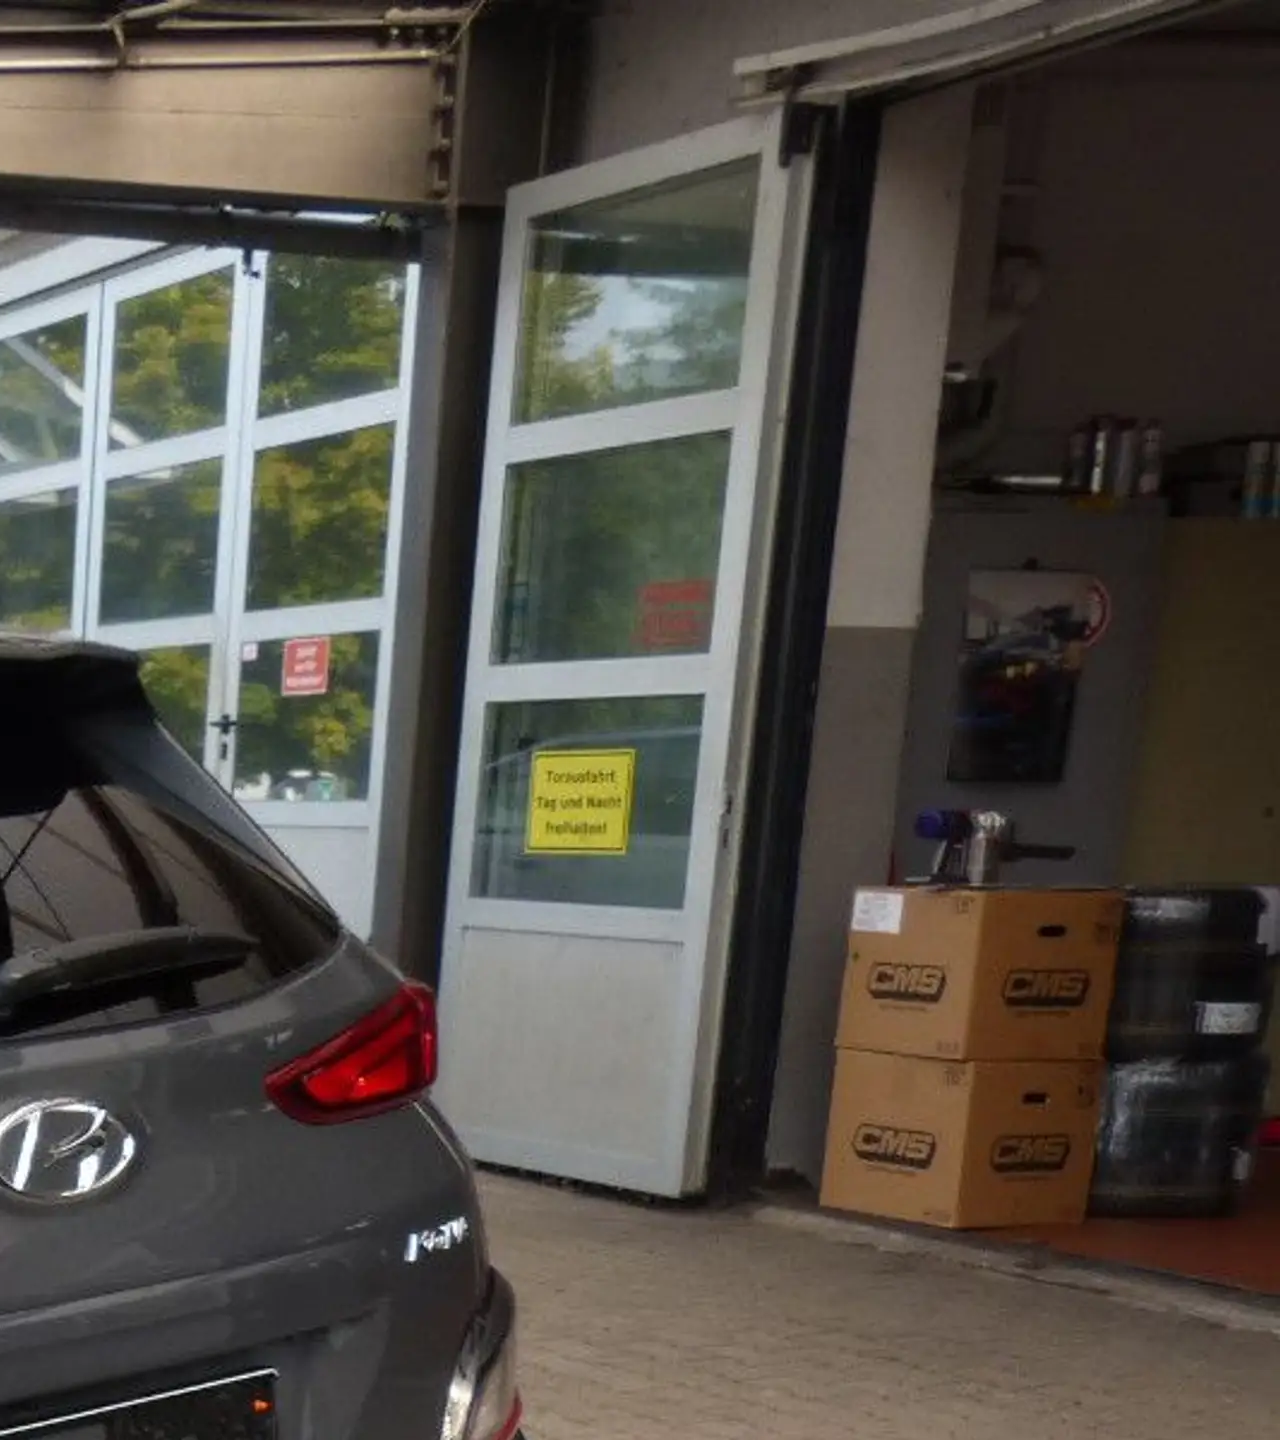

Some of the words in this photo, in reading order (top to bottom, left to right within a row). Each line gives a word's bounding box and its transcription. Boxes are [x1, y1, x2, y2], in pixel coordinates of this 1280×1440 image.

[546, 769, 616, 784] Torausfahrt
[537, 796, 556, 811] Tag
[562, 797, 583, 810] und
[586, 796, 621, 810] Nacht
[869, 963, 945, 1000] CMS
[1003, 969, 1089, 1003] CMS
[853, 1124, 935, 1165] CMS
[991, 1134, 1069, 1168] CMS
